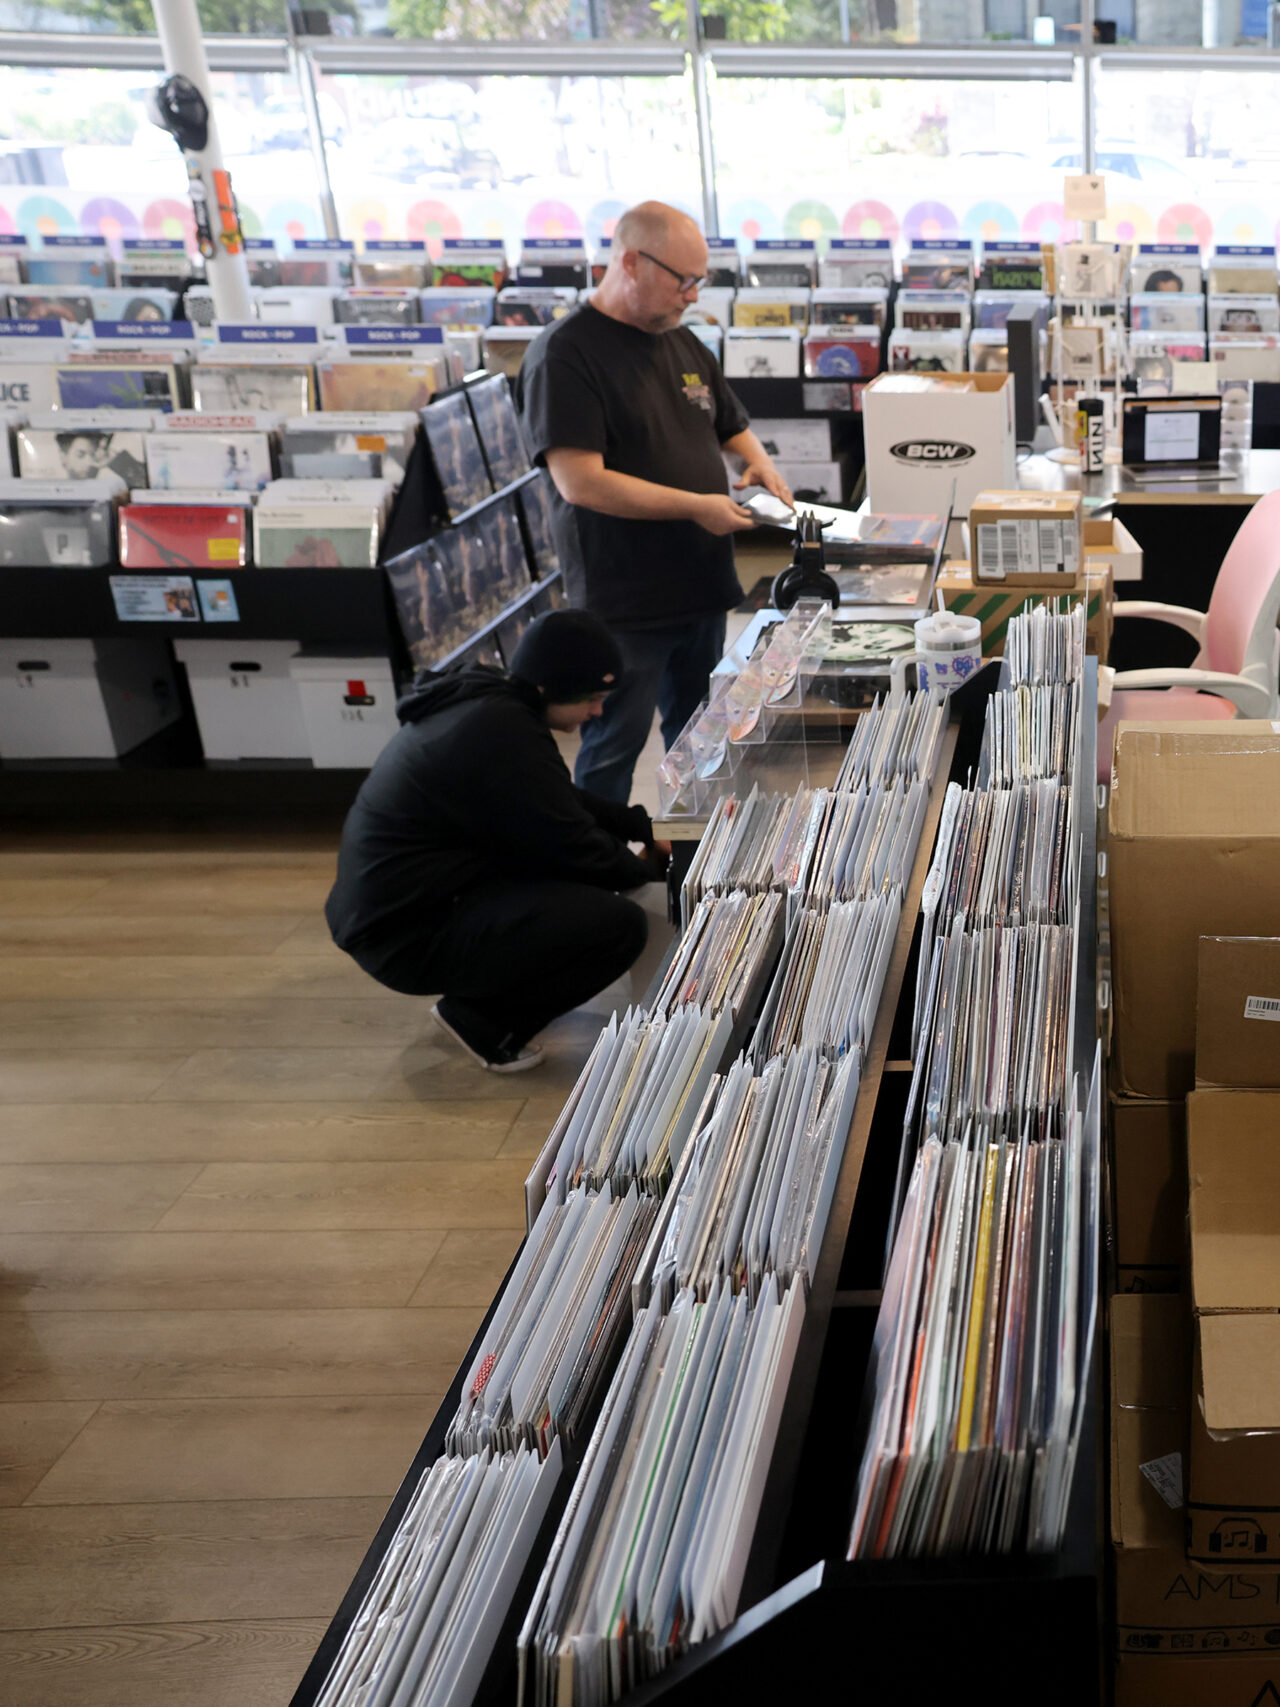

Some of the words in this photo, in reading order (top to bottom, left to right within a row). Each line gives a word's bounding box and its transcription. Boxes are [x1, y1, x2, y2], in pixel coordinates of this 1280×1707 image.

[241, 330, 269, 340] ROCK
[275, 330, 295, 340] POP
[368, 330, 395, 340] ROCK
[401, 331, 421, 340] POP
[907, 444, 958, 459] BCW
[1165, 1574, 1261, 1600] AMS
